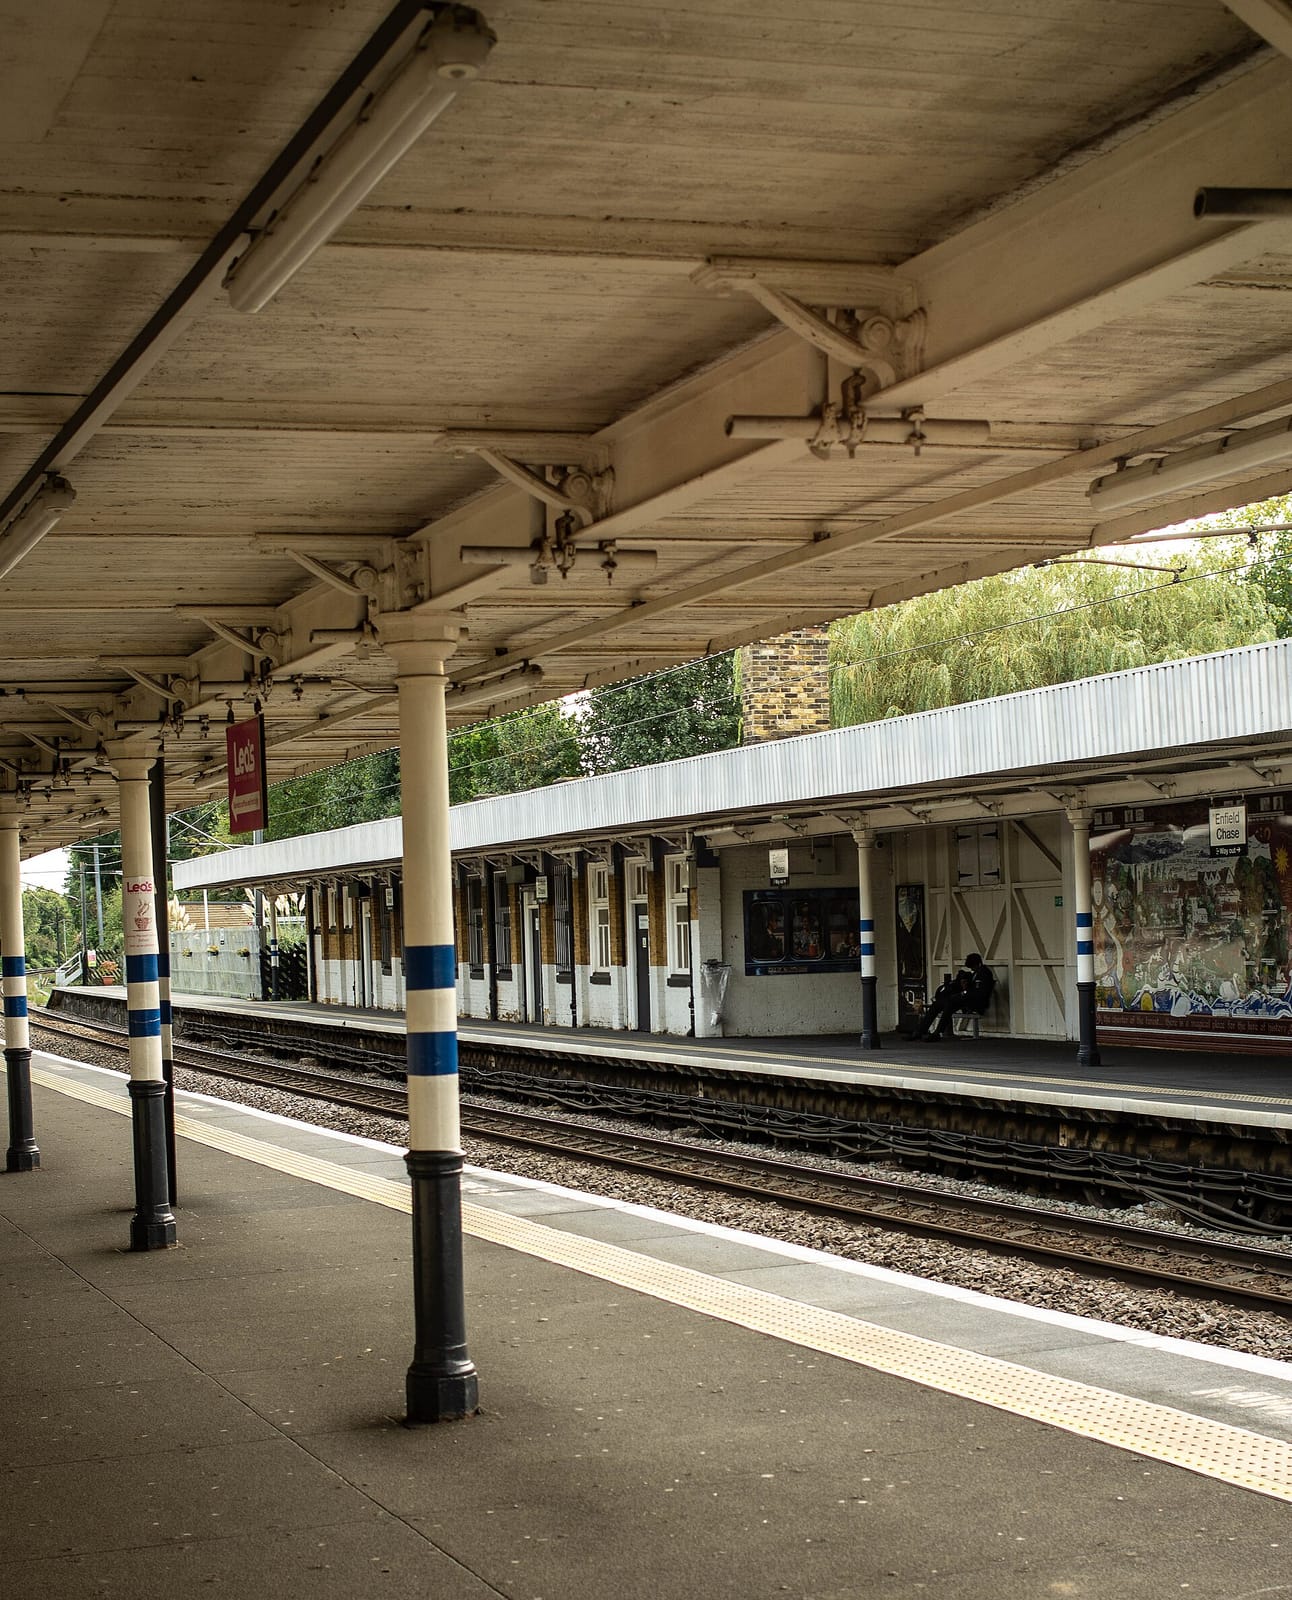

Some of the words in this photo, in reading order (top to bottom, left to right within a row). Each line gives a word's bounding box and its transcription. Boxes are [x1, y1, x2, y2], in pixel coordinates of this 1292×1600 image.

[233, 738, 255, 776] Leo's
[1215, 811, 1240, 825] Enfield
[1216, 828, 1240, 840] Chase
[127, 881, 152, 893] Leo's
